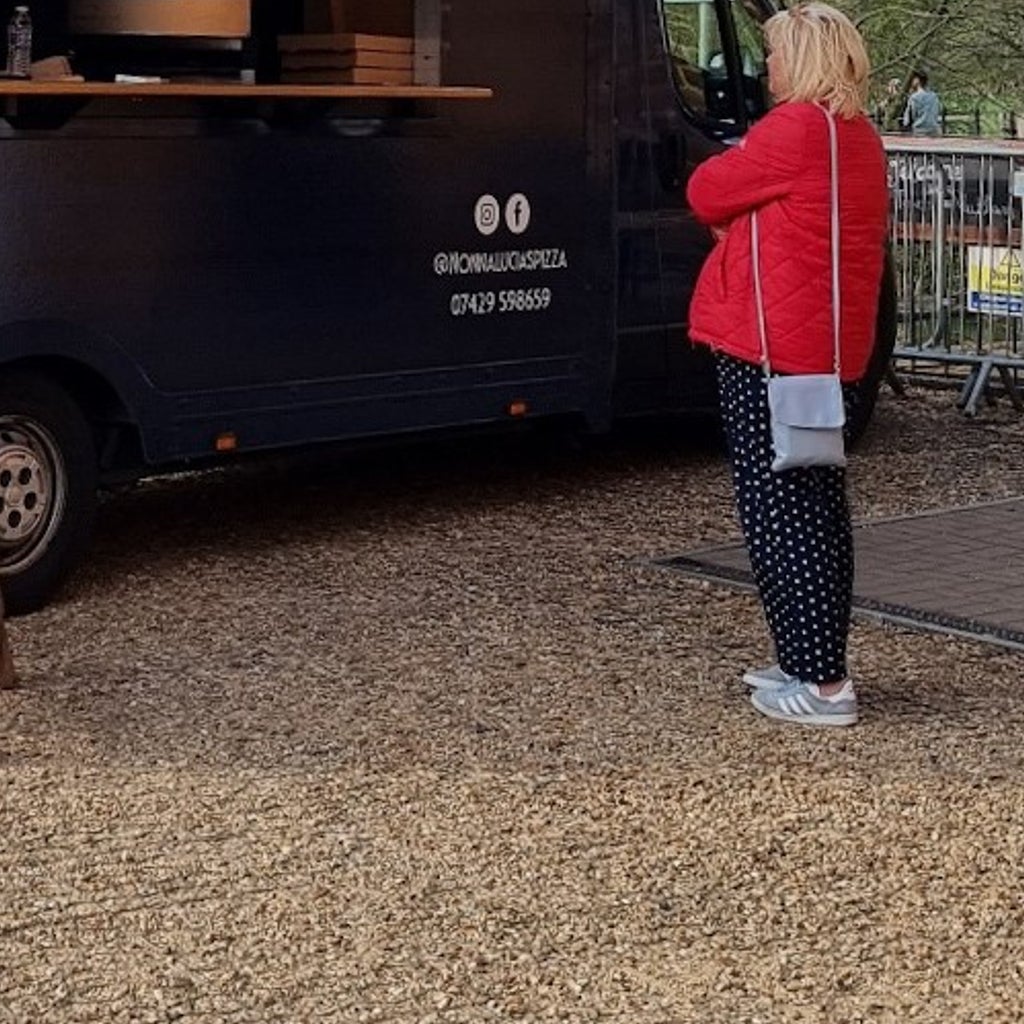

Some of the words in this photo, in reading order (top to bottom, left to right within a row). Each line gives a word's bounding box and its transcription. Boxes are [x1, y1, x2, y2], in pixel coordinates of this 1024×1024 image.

[433, 248, 568, 276] @NONNALUCIASPIZZA
[449, 290, 496, 316] 07429
[498, 287, 552, 313] 598659
